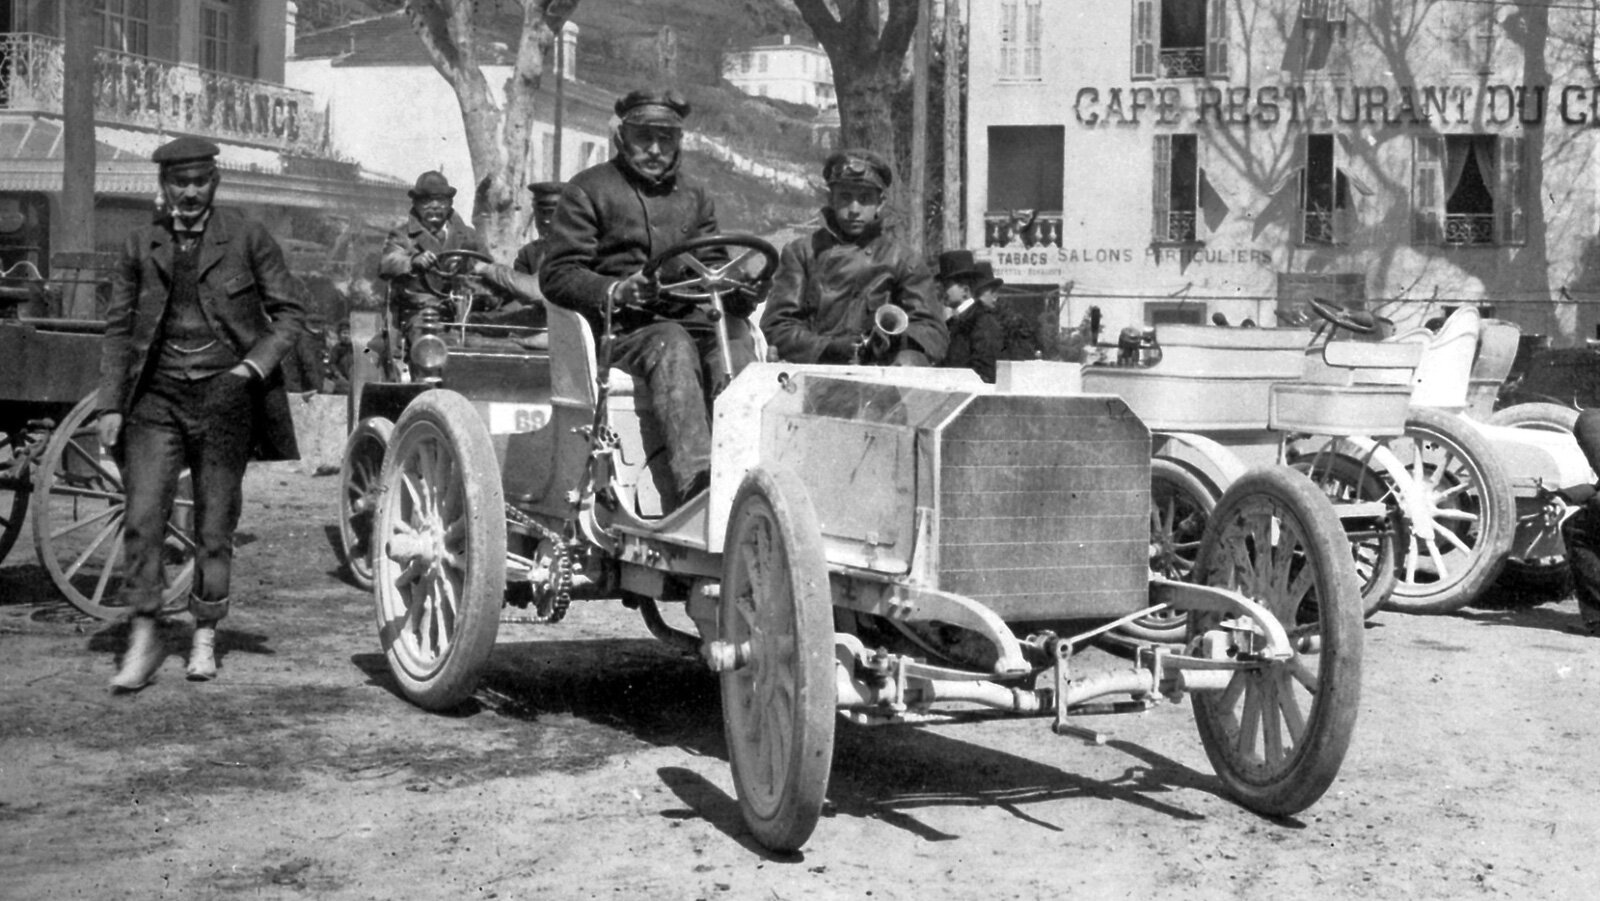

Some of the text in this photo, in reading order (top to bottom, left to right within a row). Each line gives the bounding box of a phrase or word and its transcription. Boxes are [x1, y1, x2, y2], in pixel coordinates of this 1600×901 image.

[1195, 84, 1472, 126] RESTAURANT
[1486, 84, 1546, 126] DU
[997, 251, 1048, 265] TABACS
[1057, 247, 1133, 263] SALONS
